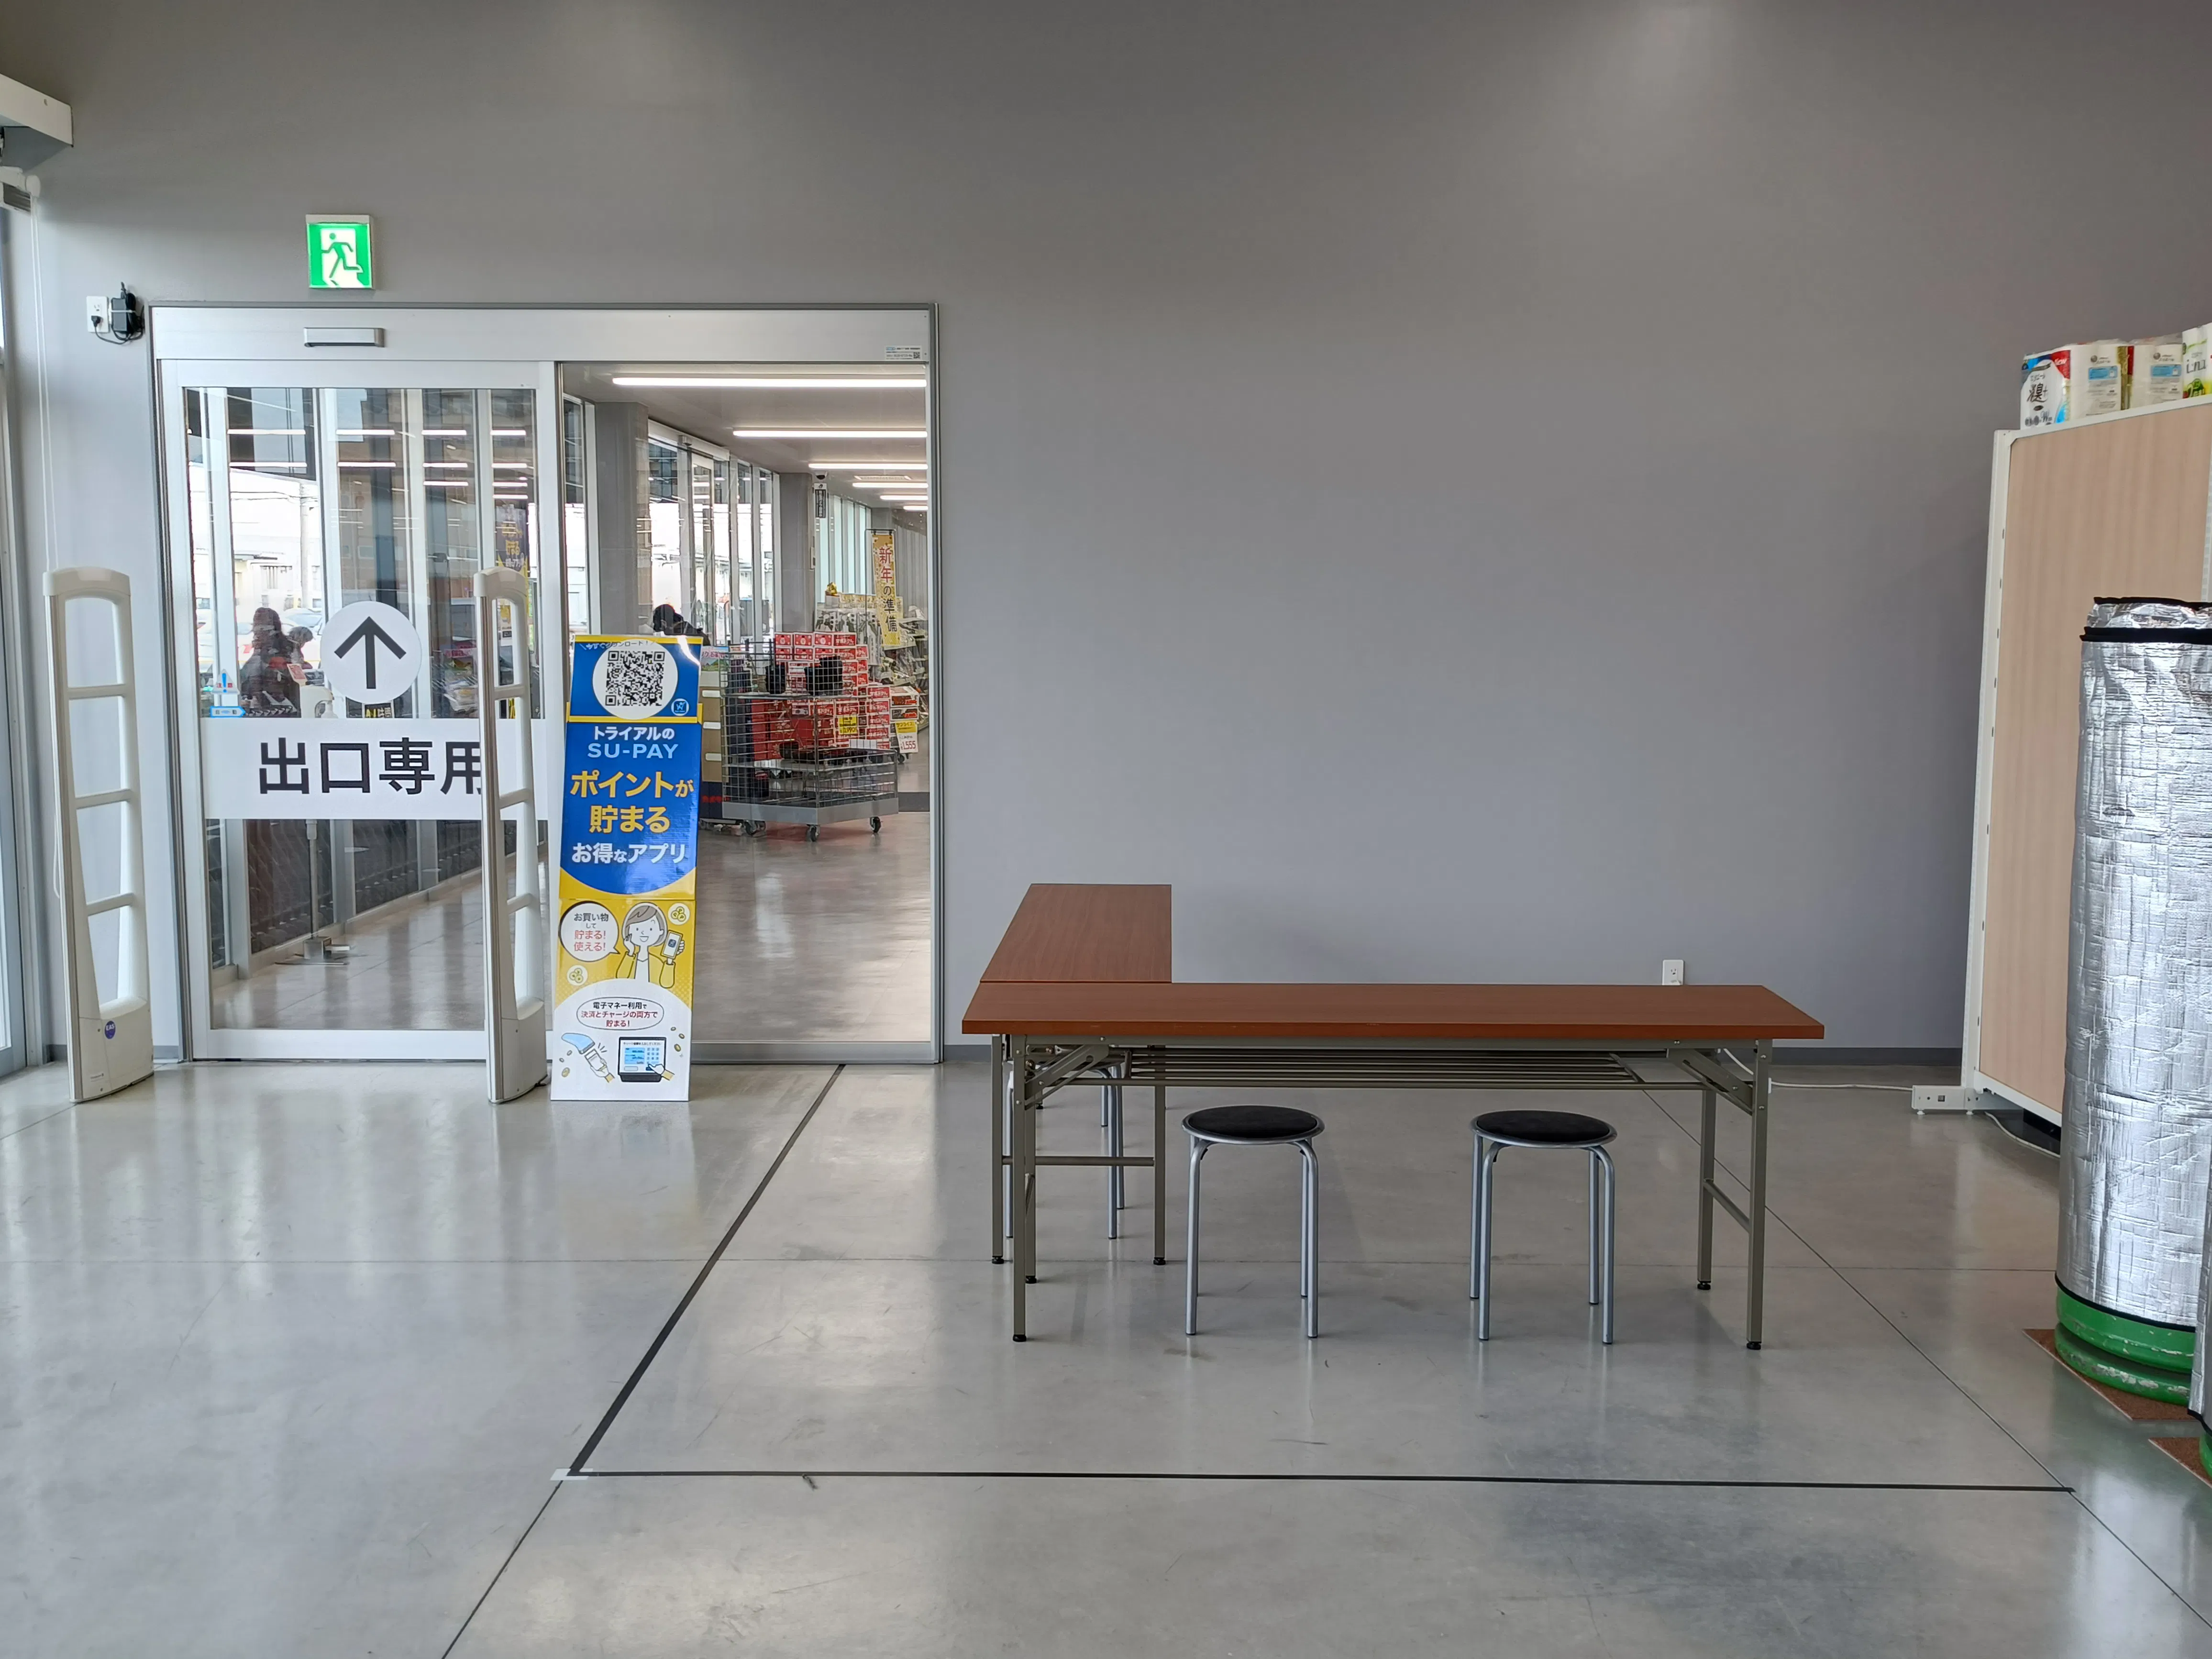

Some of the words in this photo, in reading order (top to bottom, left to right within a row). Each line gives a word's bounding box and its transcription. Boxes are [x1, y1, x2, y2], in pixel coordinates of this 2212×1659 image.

[879, 547, 897, 632] 新年の準備
[594, 727, 675, 741] トライアルの
[587, 743, 679, 759] SU-PAY
[259, 737, 481, 795] 出口専用
[570, 770, 694, 798] ポイントが
[589, 805, 670, 833] 貯まる
[572, 842, 686, 863] お得なアプリ
[574, 913, 608, 922] お買い物
[574, 930, 606, 940] 貯まる!
[574, 941, 606, 951] 使える!
[593, 1002, 647, 1010] 電子マネー利用で
[581, 1010, 658, 1019] 決済とチャージの両方で
